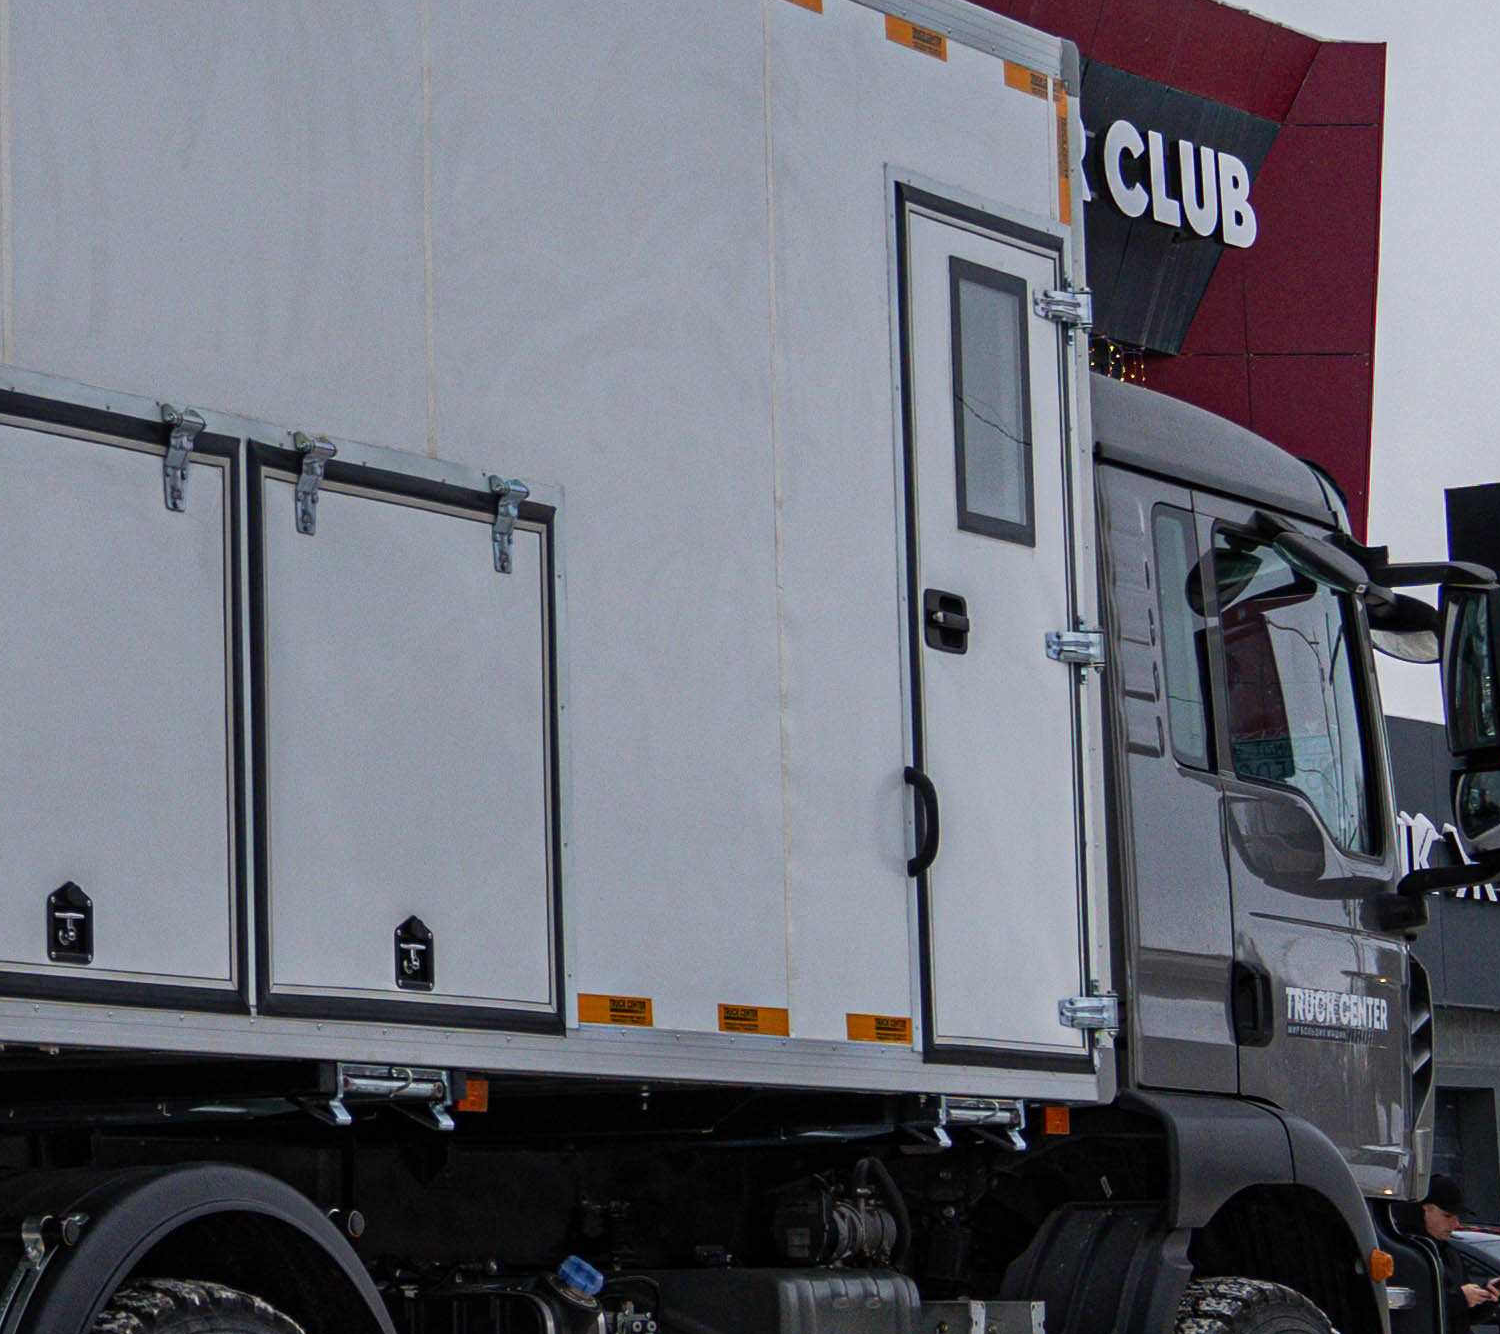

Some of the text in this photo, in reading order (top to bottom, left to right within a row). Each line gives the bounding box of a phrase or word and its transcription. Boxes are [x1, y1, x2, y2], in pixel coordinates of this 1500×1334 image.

[1104, 119, 1258, 248] CLUB
[1286, 986, 1389, 1031] TRUCK CENTER
